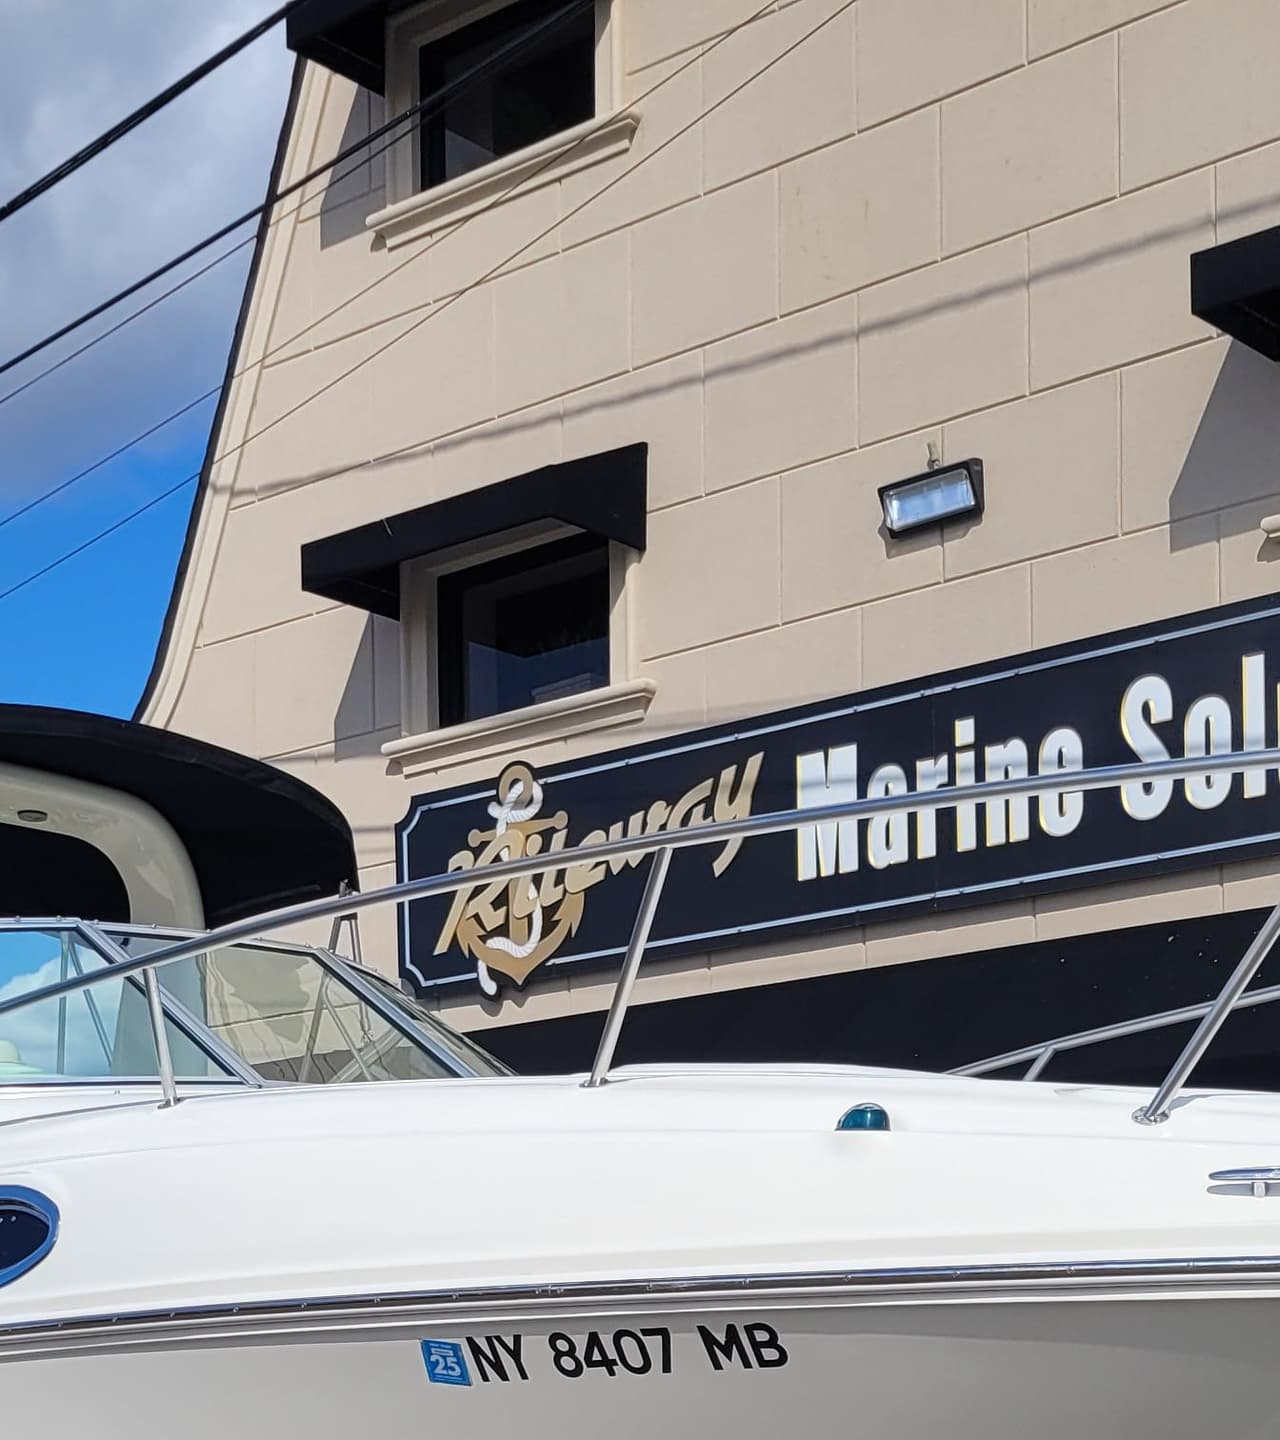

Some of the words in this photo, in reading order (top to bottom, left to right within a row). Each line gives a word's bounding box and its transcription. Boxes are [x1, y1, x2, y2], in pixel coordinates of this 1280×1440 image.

[796, 716, 1084, 882] Marine
[430, 1354, 462, 1377] 25
[465, 1334, 529, 1382] NY
[548, 1327, 671, 1378] 8407
[696, 1322, 789, 1371] MB
